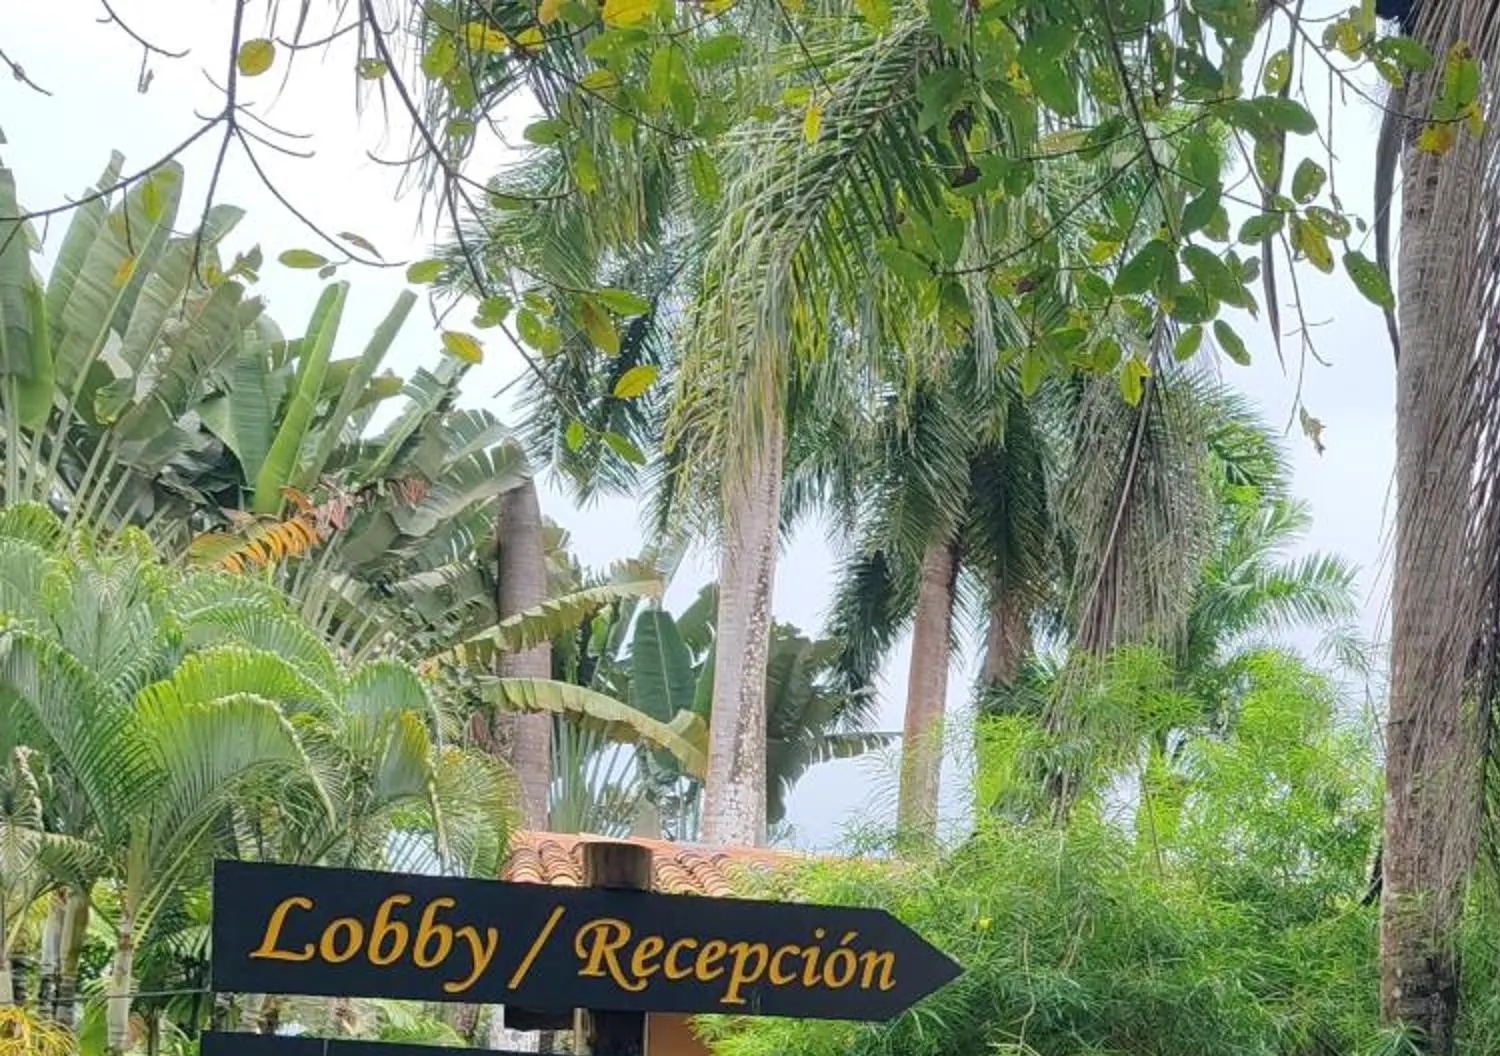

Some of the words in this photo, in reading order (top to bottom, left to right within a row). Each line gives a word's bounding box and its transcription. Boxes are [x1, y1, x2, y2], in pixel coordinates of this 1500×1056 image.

[250, 894, 498, 992] Lobby
[508, 905, 564, 990] /
[575, 918, 896, 1004] Recepción
